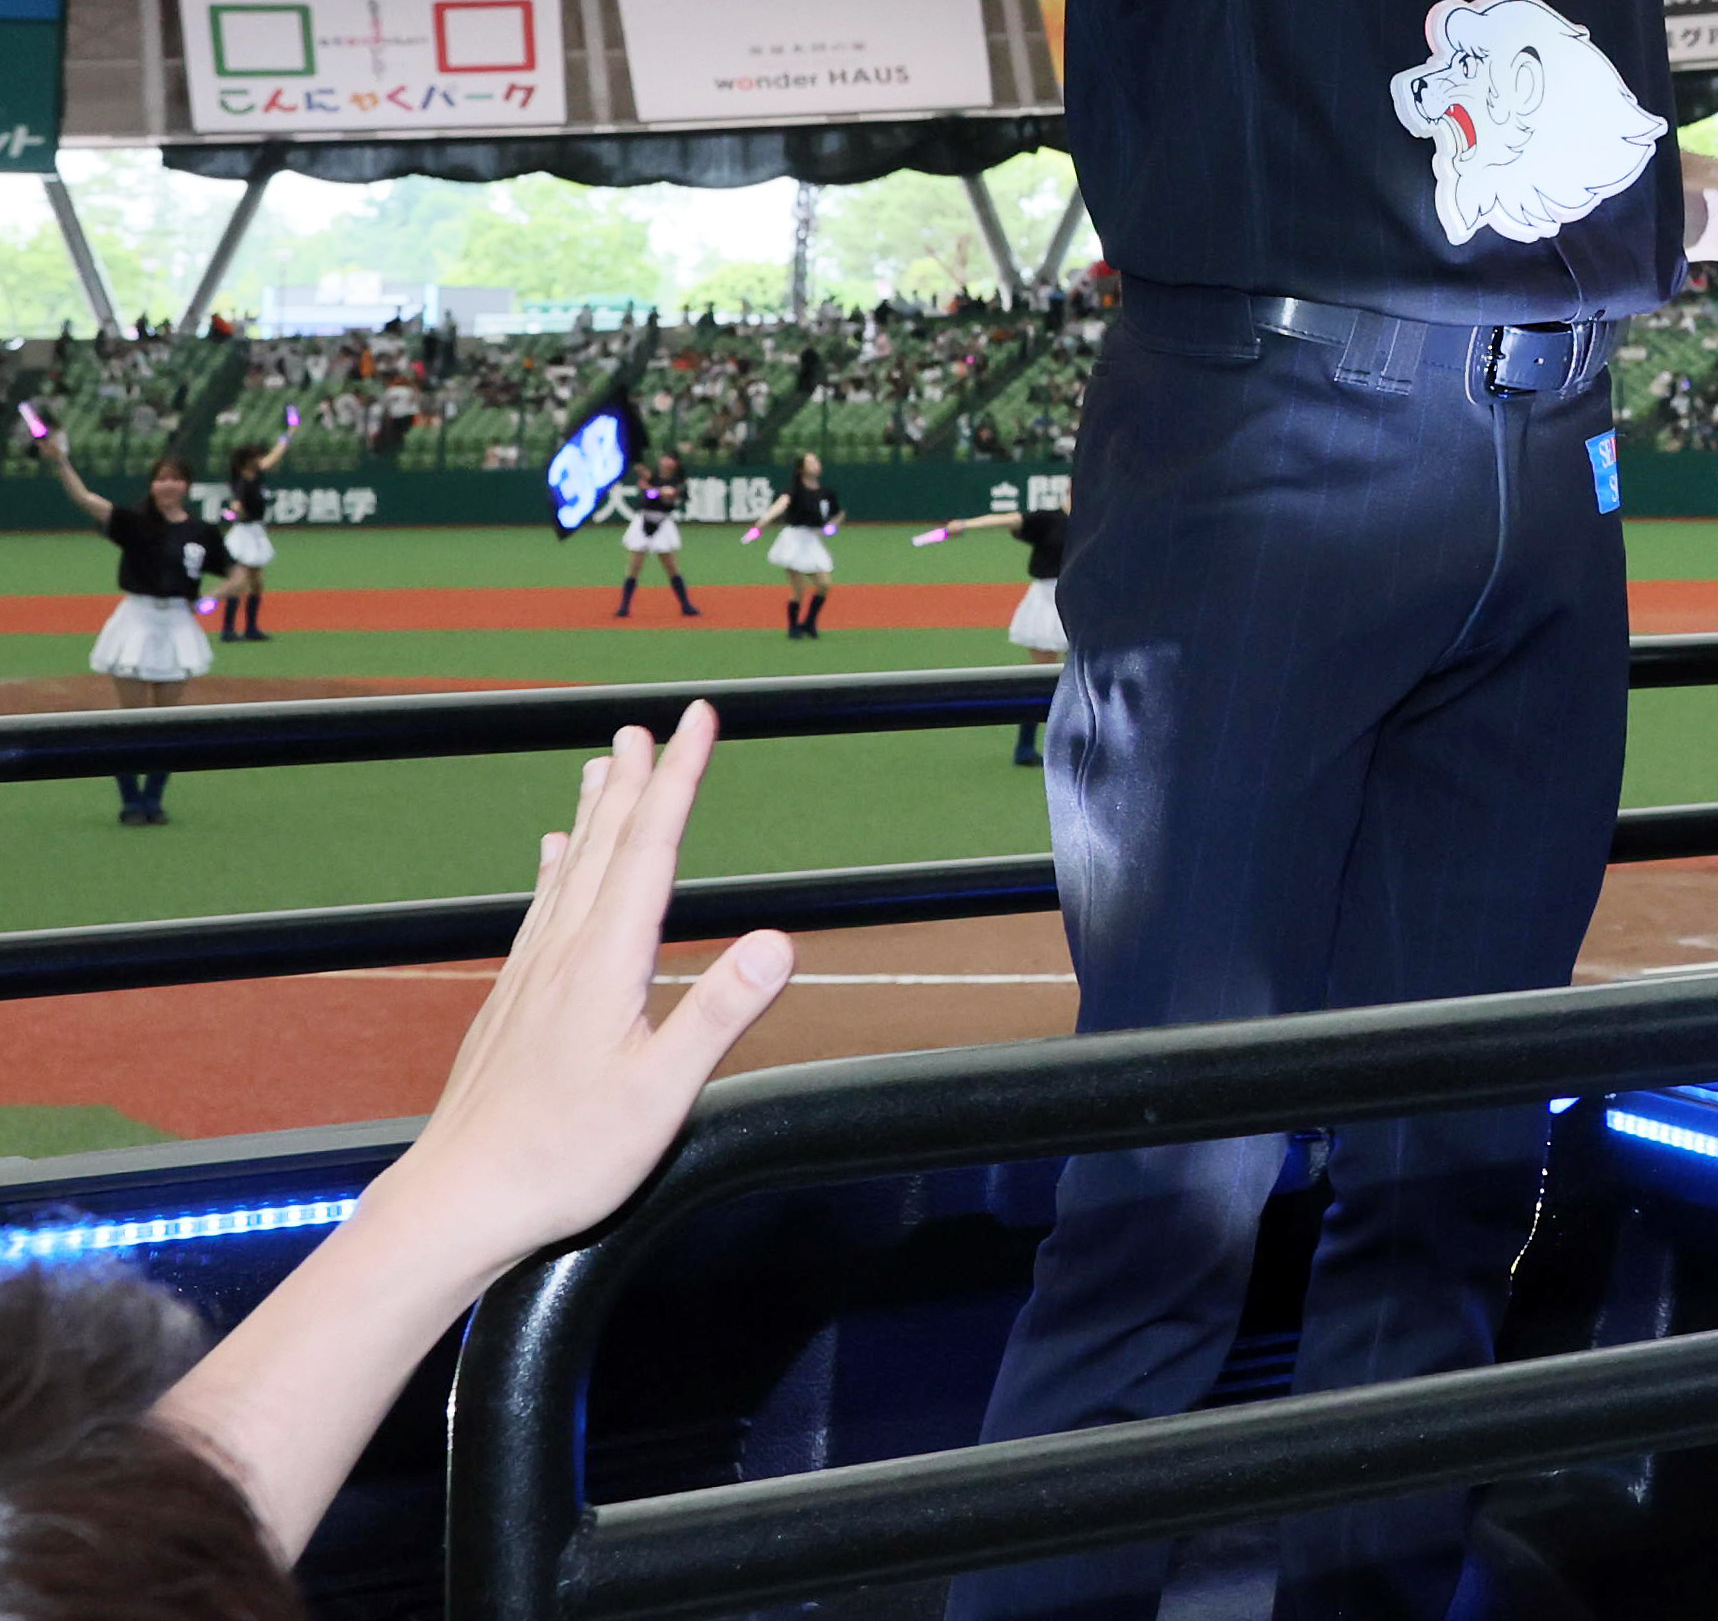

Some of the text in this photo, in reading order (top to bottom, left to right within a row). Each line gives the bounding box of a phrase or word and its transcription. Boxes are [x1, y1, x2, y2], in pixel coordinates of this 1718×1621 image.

[714, 64, 910, 92] wonder HAUS
[218, 82, 537, 116] こんにゃくパーク
[263, 486, 378, 524] 砂熱学
[592, 476, 776, 523] 大建設
